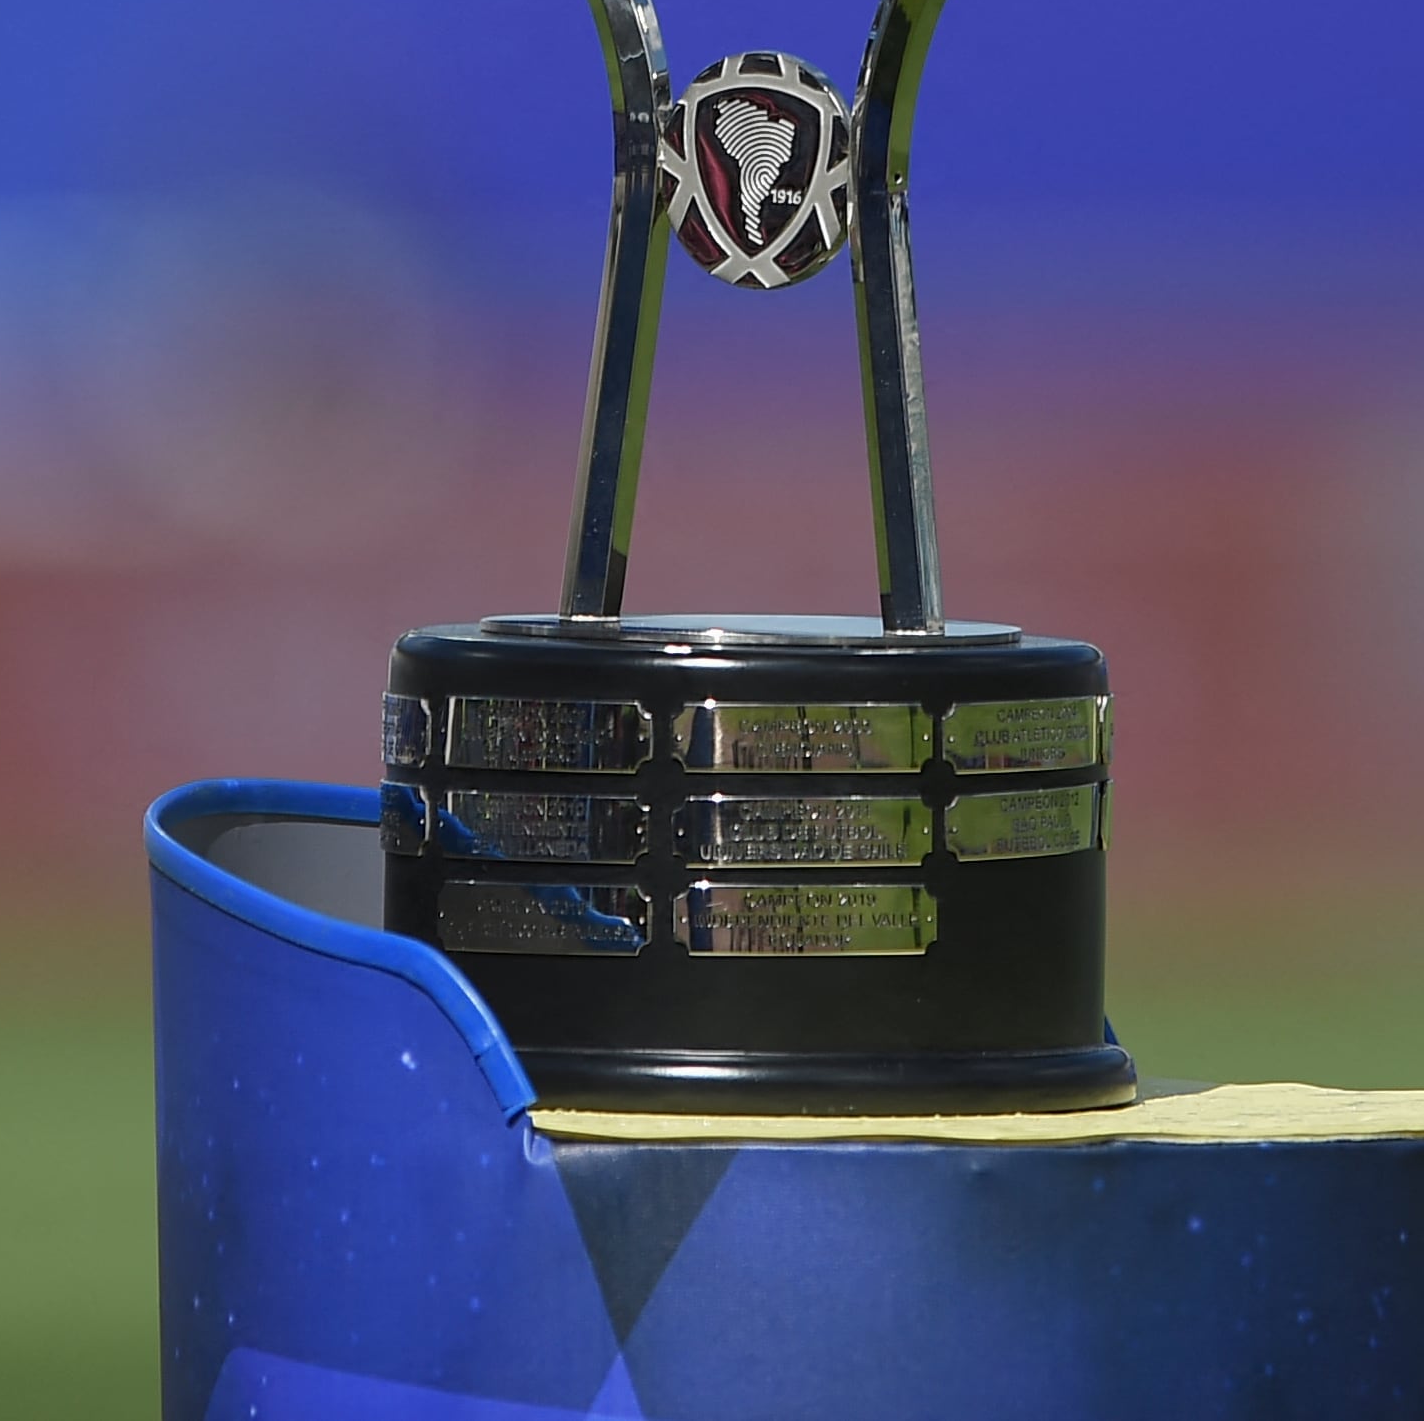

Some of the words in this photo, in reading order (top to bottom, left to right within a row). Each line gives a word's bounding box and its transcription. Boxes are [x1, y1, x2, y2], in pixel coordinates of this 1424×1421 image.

[771, 190, 802, 205] 1916
[829, 843, 854, 860] DE
[743, 893, 833, 909] CAMPEON
[837, 893, 877, 909] 2019
[836, 913, 864, 929] DEL
[871, 913, 918, 929] VALLE
